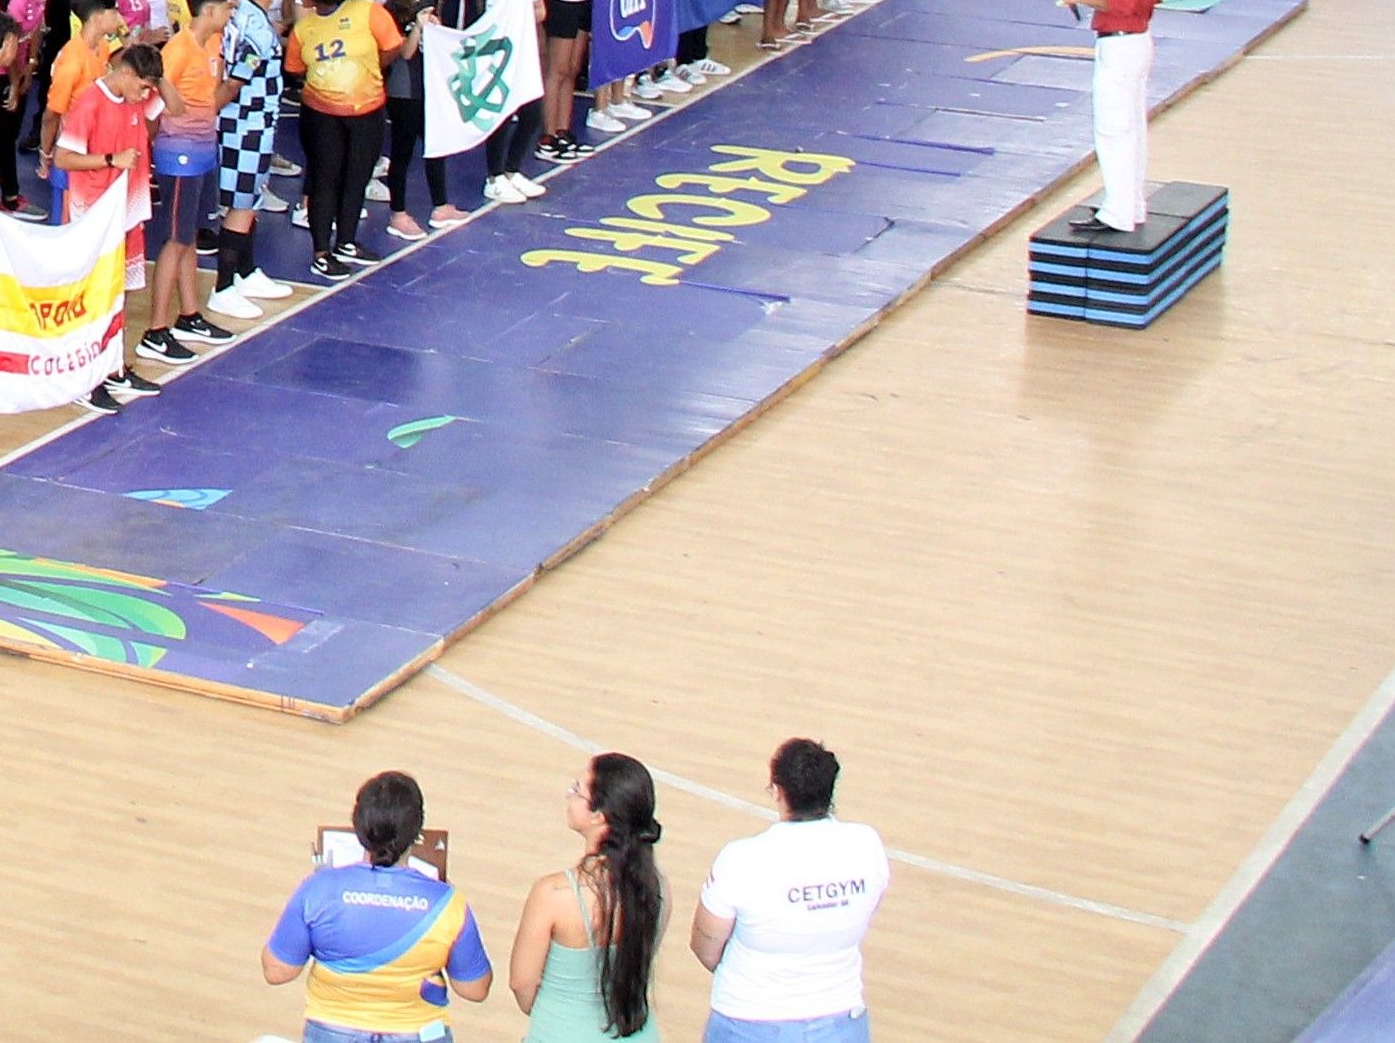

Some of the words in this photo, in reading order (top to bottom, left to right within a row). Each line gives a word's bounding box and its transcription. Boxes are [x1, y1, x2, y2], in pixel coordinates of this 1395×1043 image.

[314, 39, 346, 62] 12
[521, 145, 856, 286] RECIFE
[342, 890, 429, 911] COORDENAÇÃO
[787, 878, 866, 903] CETGYM
